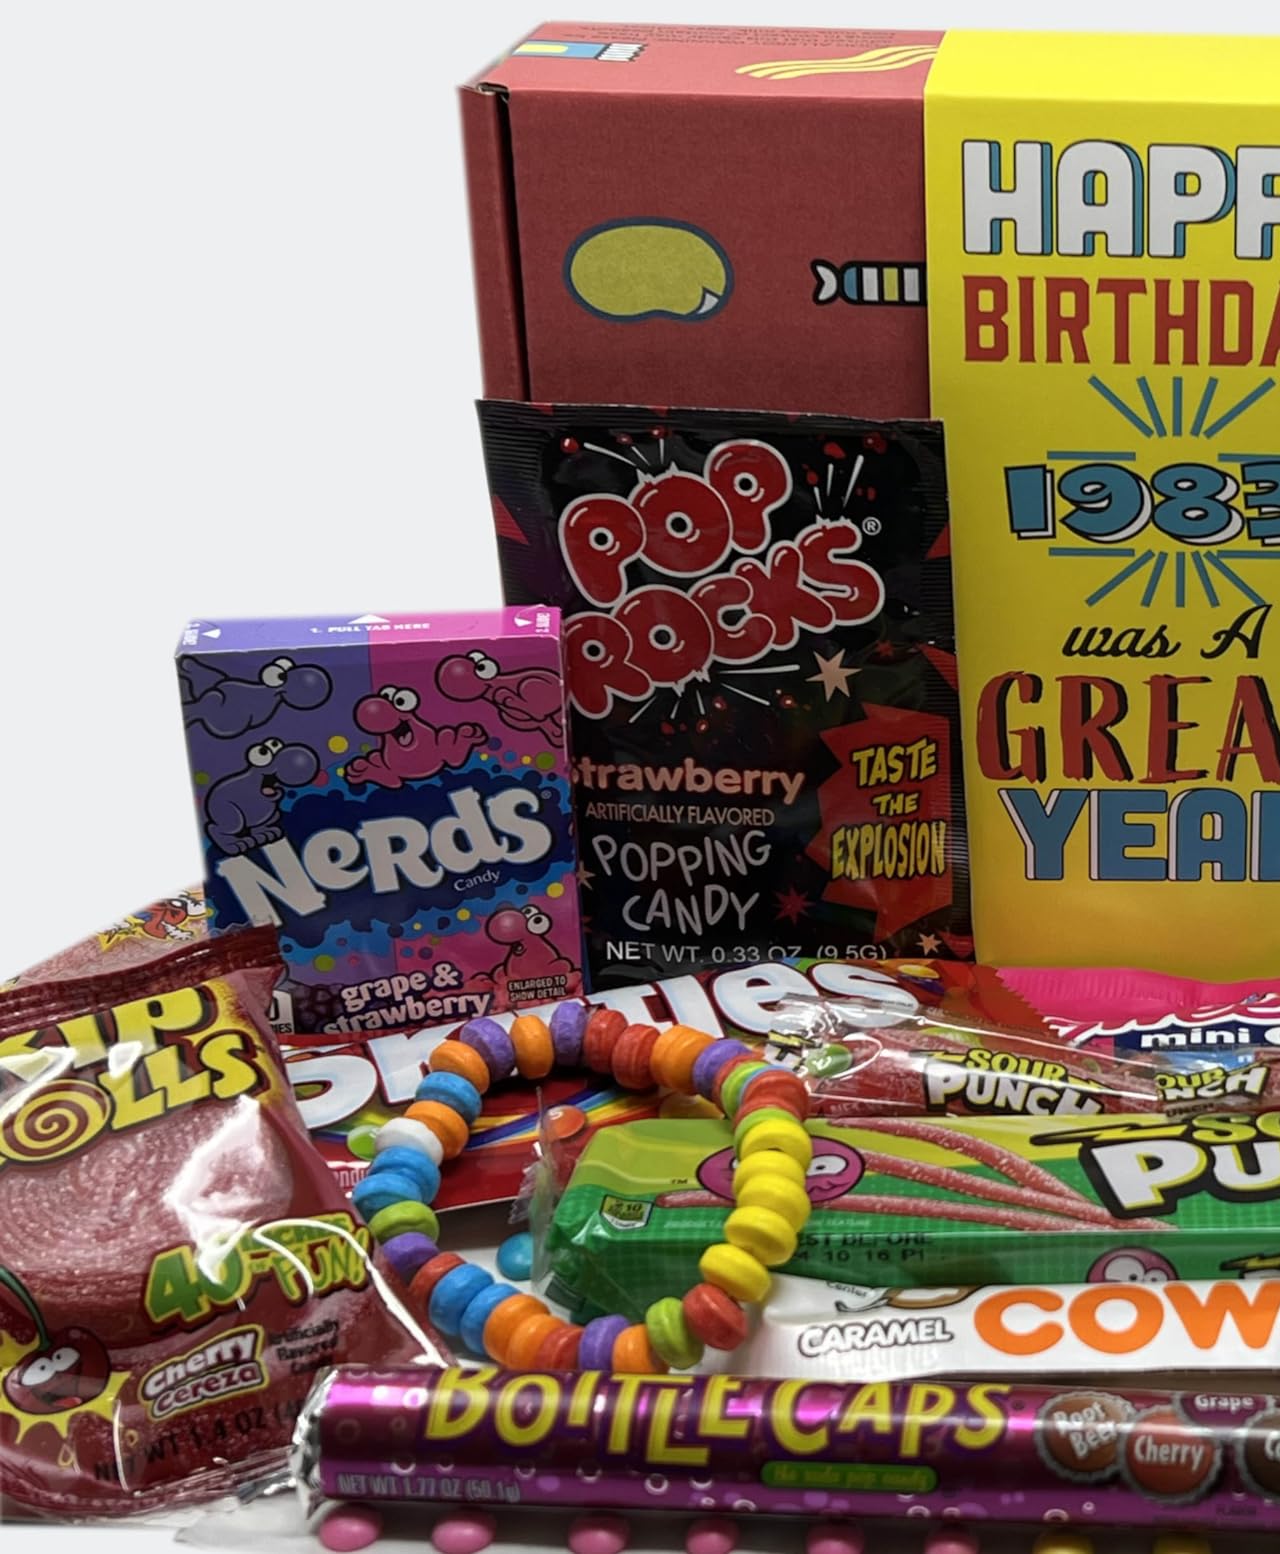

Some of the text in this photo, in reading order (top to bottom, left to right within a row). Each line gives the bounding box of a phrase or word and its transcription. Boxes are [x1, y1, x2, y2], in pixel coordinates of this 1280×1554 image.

[558, 439, 793, 608] POP
[564, 515, 885, 720] ROCKS
[1062, 604, 1272, 658] was A
[572, 757, 805, 804] trawberry
[852, 738, 938, 788] TASTE
[585, 802, 776, 826] ARTIFICIALLY FLAVORED
[872, 793, 919, 817] THE
[592, 829, 772, 886] POPPING
[830, 821, 946, 881] EXPLOSION
[454, 869, 501, 892] Candy
[622, 885, 760, 936] CANDY
[606, 941, 887, 962] NET WT. 0.33 OZ (95G)
[340, 962, 459, 1012] grape &
[507, 976, 568, 992] ENLARGED TO
[509, 987, 566, 1001] SHOW DETAIL
[323, 992, 491, 1034] strawberry
[1141, 1027, 1249, 1048] mini
[967, 1049, 1069, 1086] SOUR
[1155, 1069, 1225, 1089] OUR
[925, 1064, 1105, 1115] PUNCH
[797, 1232, 831, 1246] EST
[798, 1316, 953, 1357] CARAMEL
[769, 1379, 1012, 1458] CAPS
[1194, 1394, 1254, 1413] Grape
[1134, 1434, 1205, 1473] Cherry
